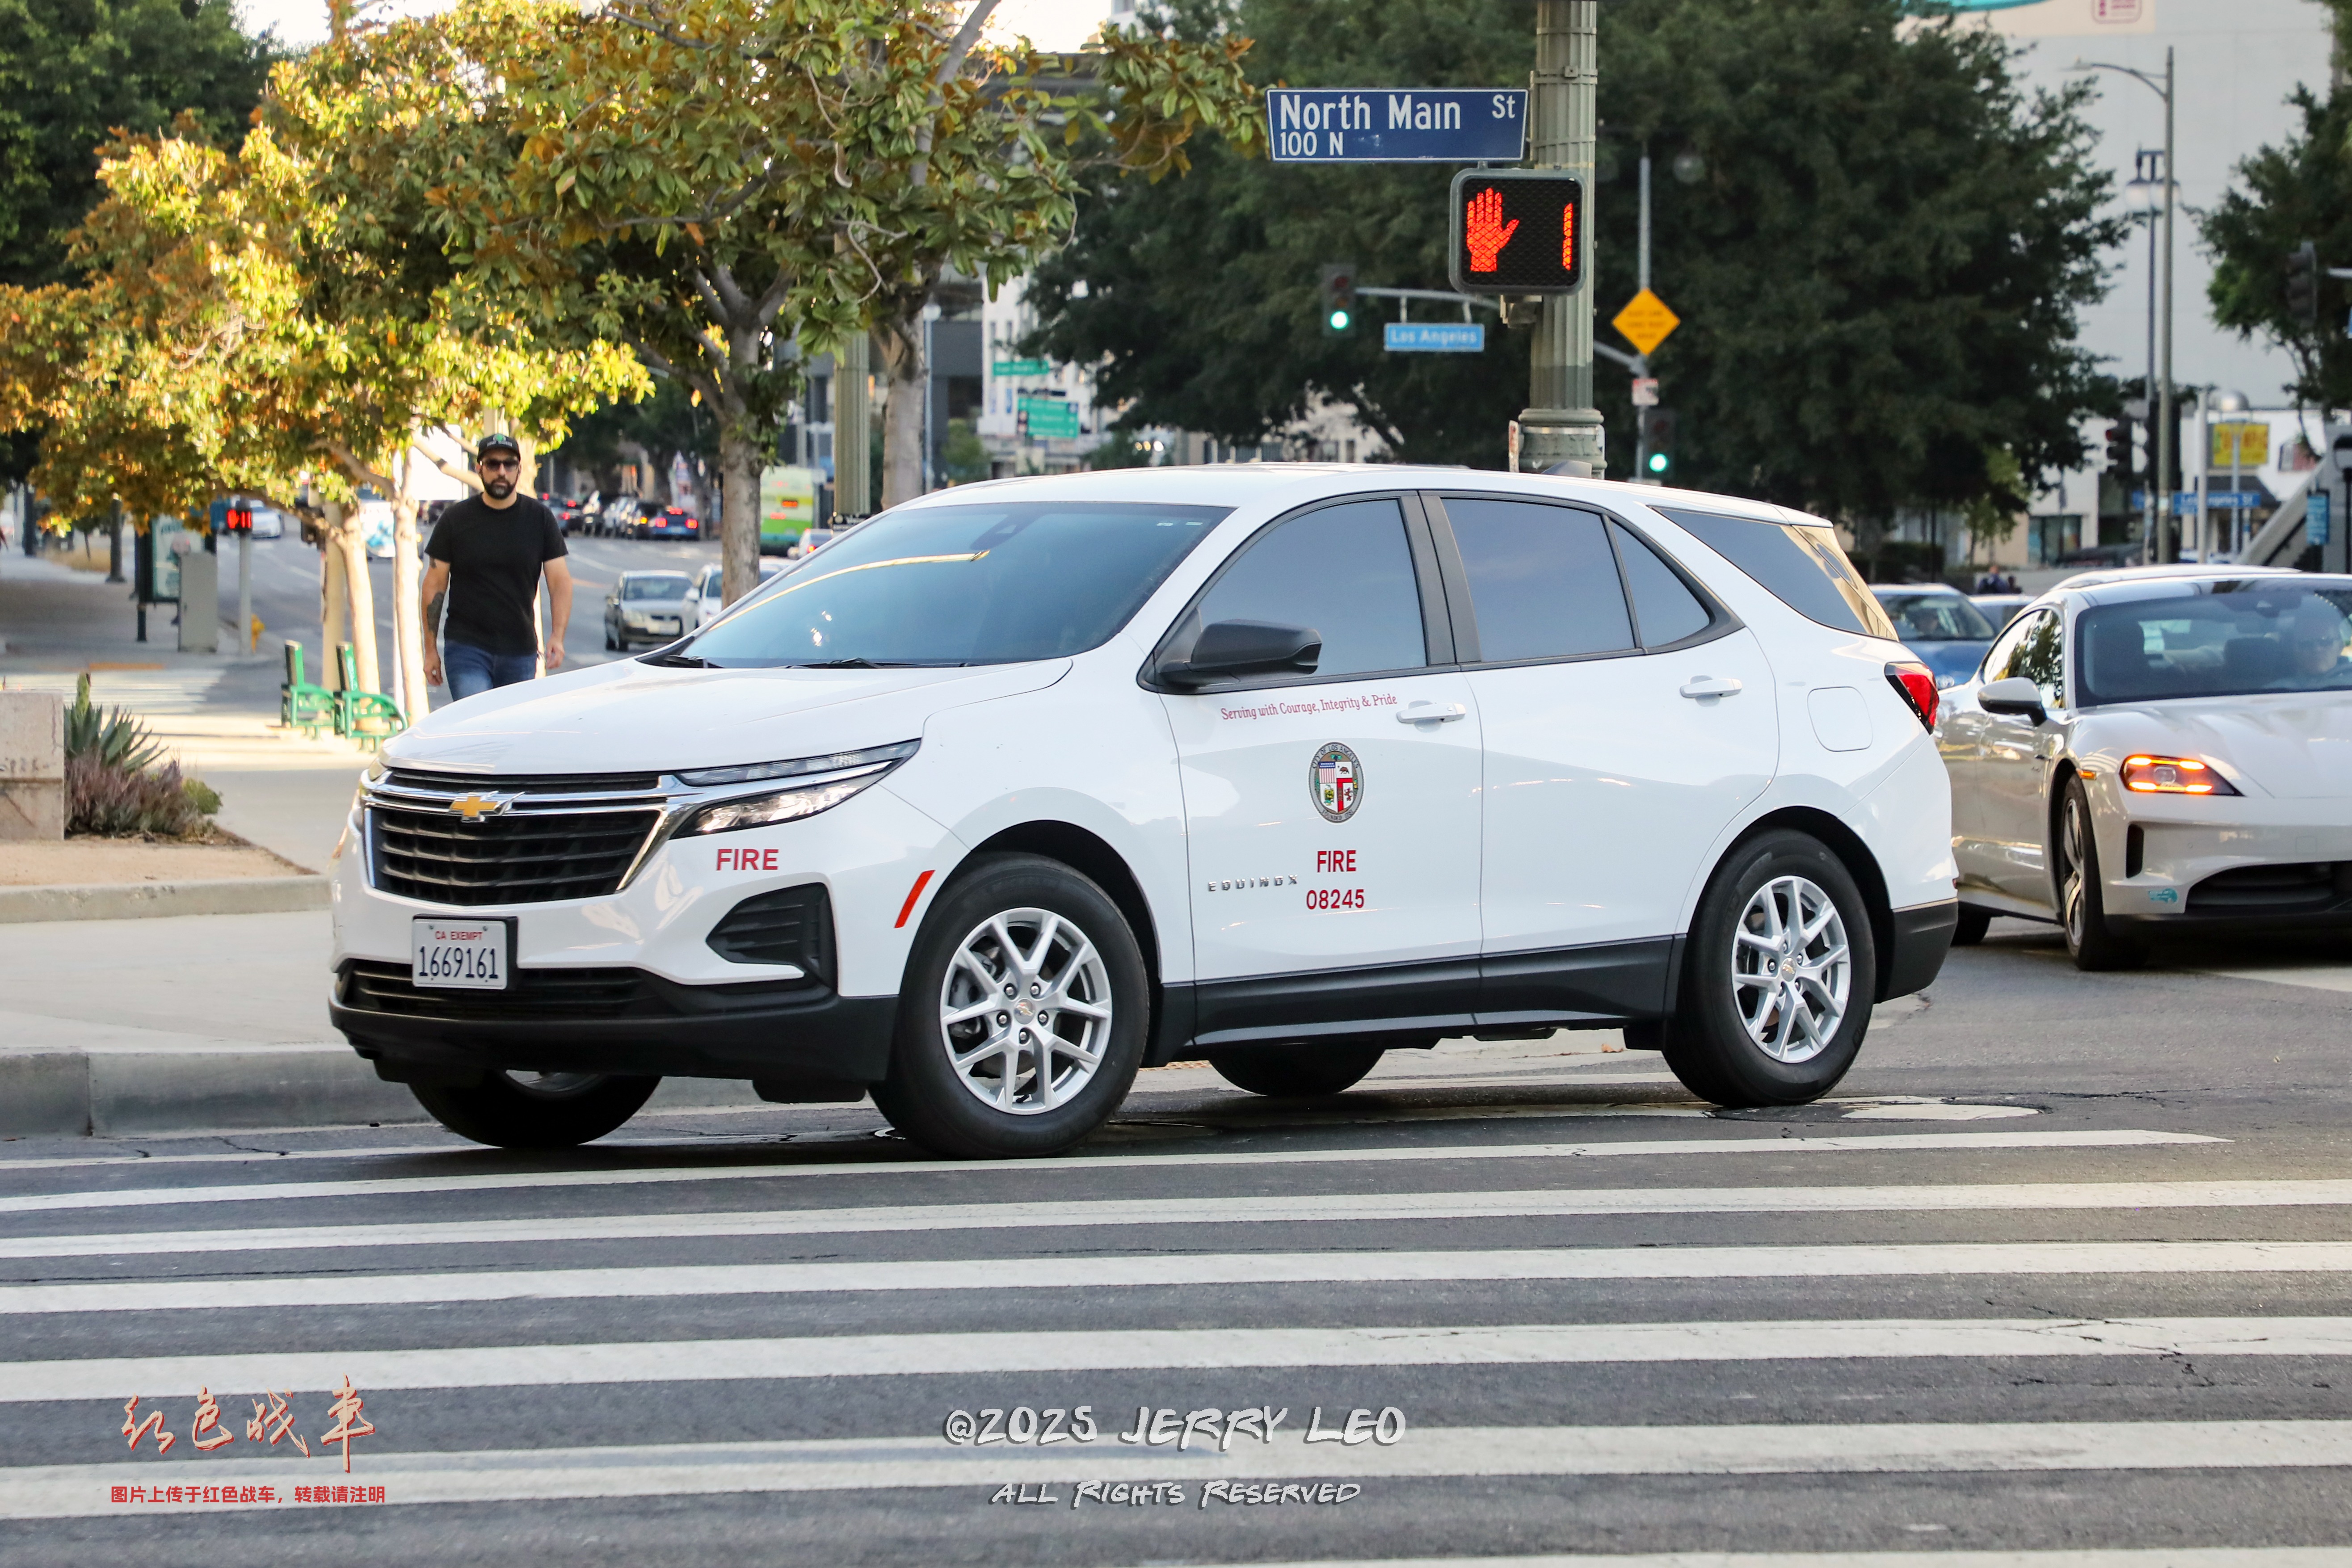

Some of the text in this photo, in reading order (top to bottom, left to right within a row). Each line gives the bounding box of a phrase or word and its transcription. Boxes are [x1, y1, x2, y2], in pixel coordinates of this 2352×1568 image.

[1280, 94, 1515, 130] North Main St
[1281, 132, 1343, 156] 100 N
[1391, 328, 1477, 347] Los Angeles
[1221, 693, 1397, 720] Serving with Courage, Integrity & Pride
[716, 849, 779, 871] FIRE
[1317, 849, 1356, 873] FIRE
[1208, 874, 1298, 892] EQUINOX
[1306, 889, 1364, 910] 08245
[435, 931, 483, 940] CA EXEMPT
[419, 946, 498, 979] 1669161
